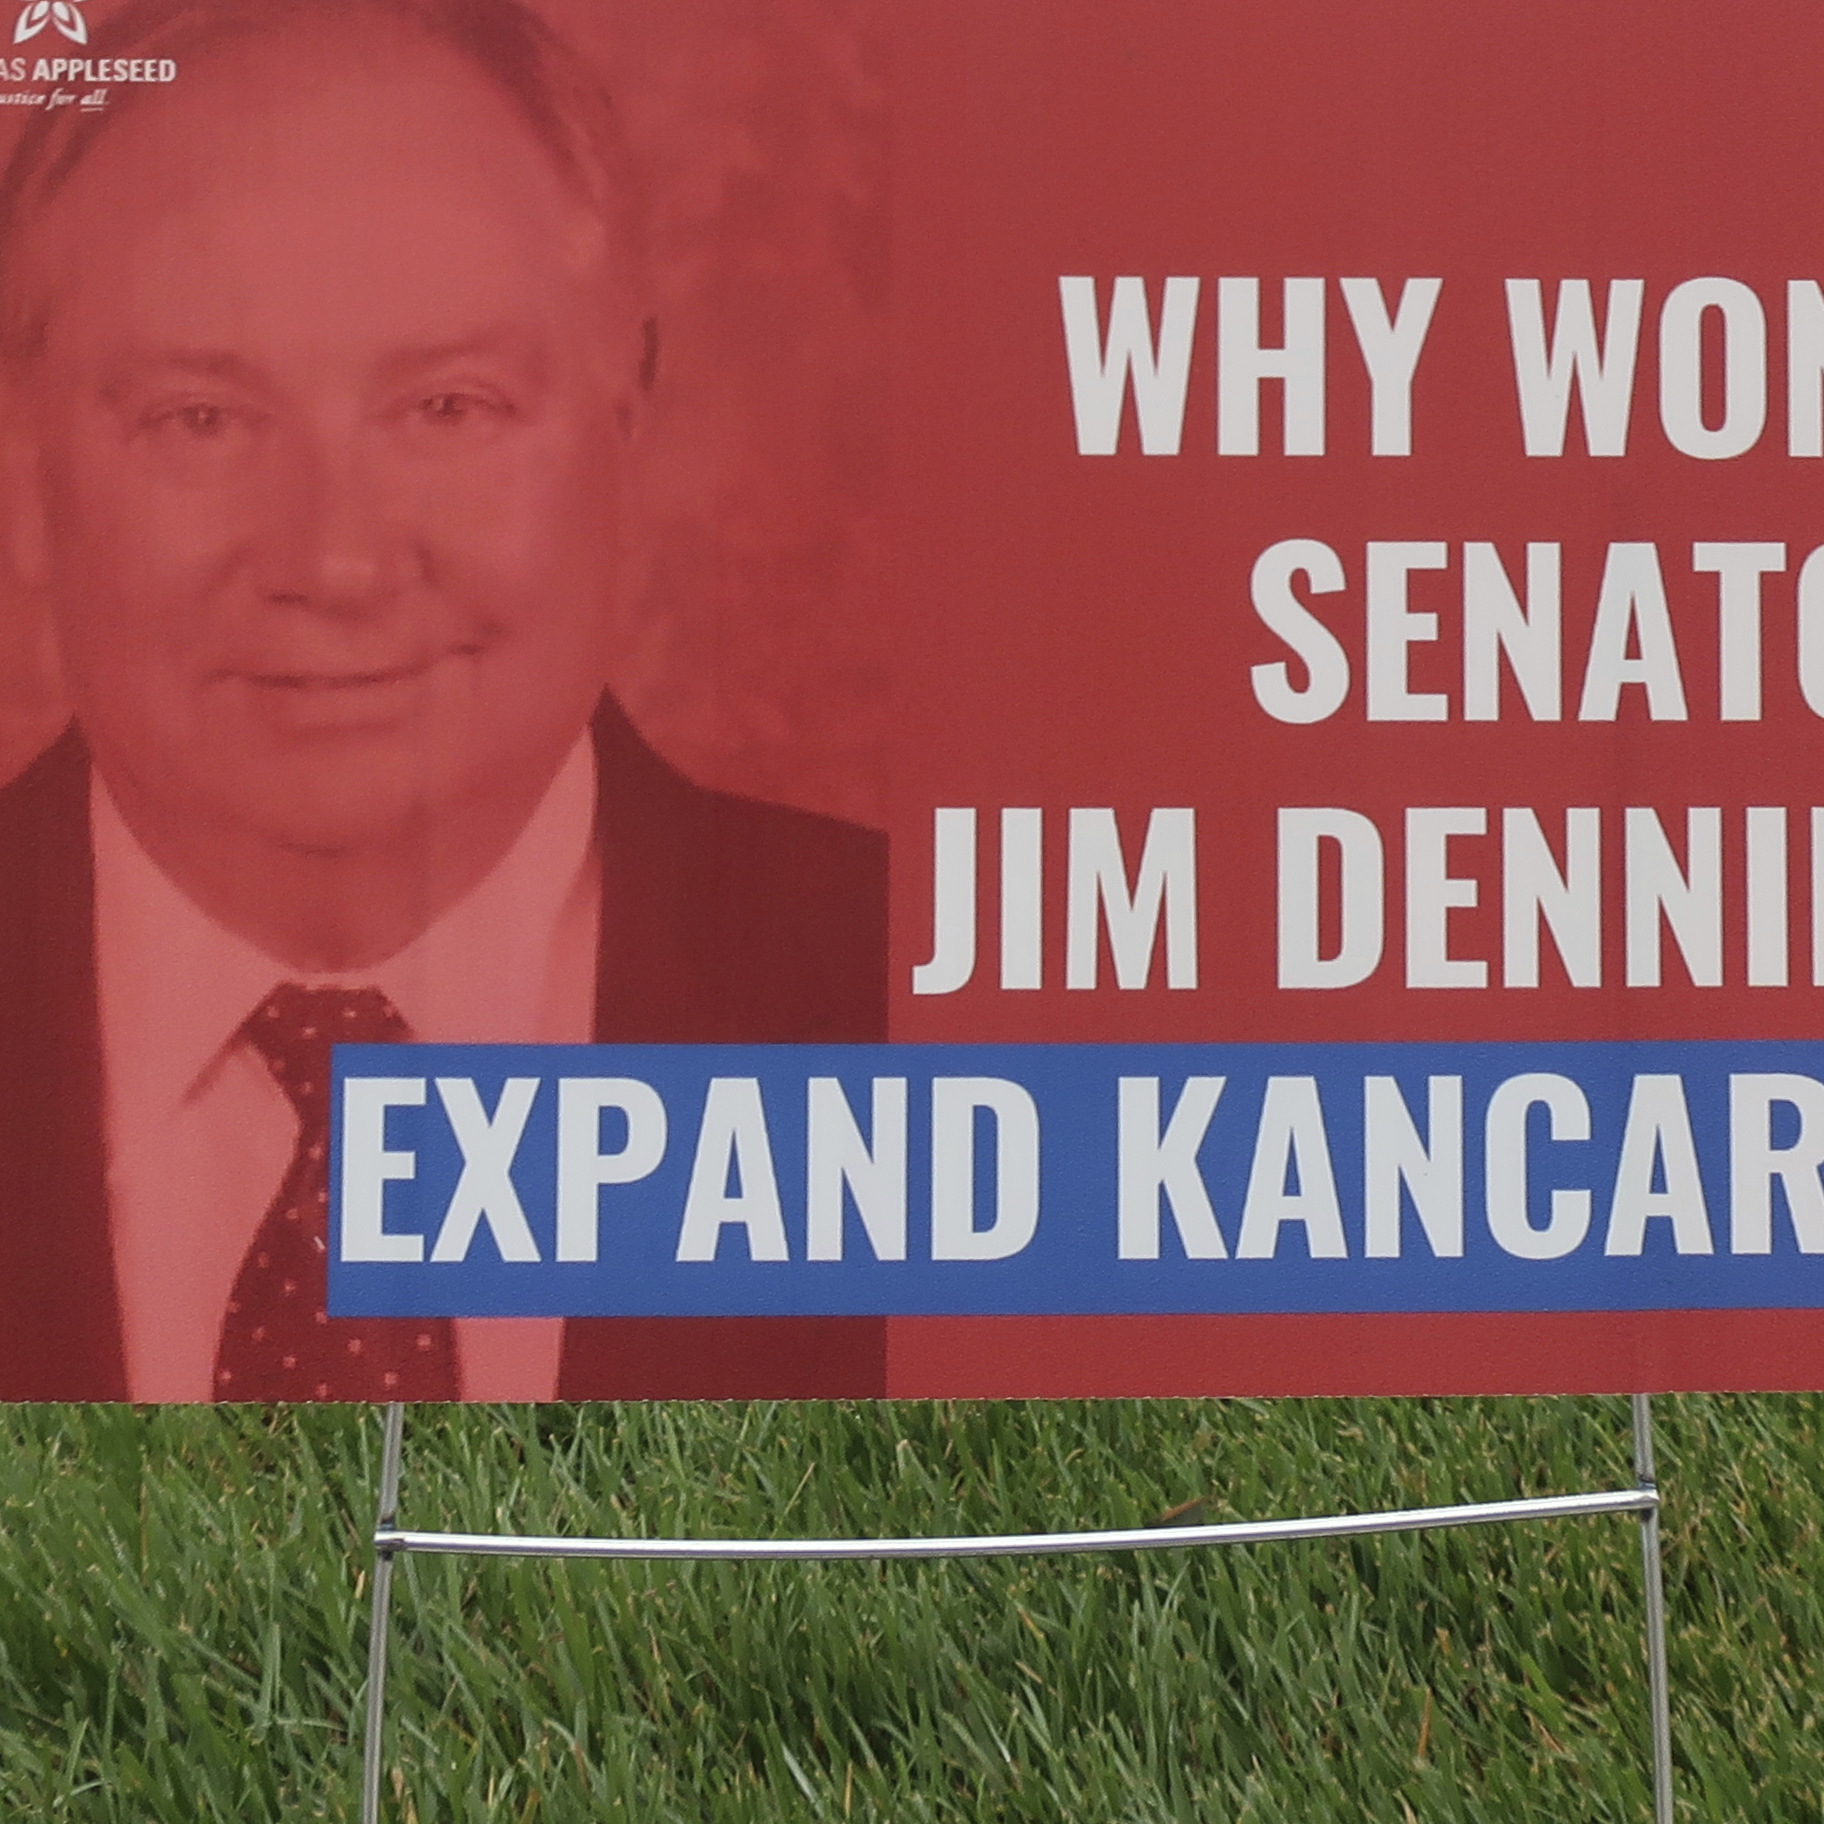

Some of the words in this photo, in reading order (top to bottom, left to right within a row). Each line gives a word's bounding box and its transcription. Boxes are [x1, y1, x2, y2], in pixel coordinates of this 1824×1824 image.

[32, 58, 177, 83] APPLESEED
[45, 87, 77, 111] for
[1059, 276, 1442, 456] WHY
[913, 808, 1197, 995] JIM
[341, 1077, 1039, 1262] EXPAND
